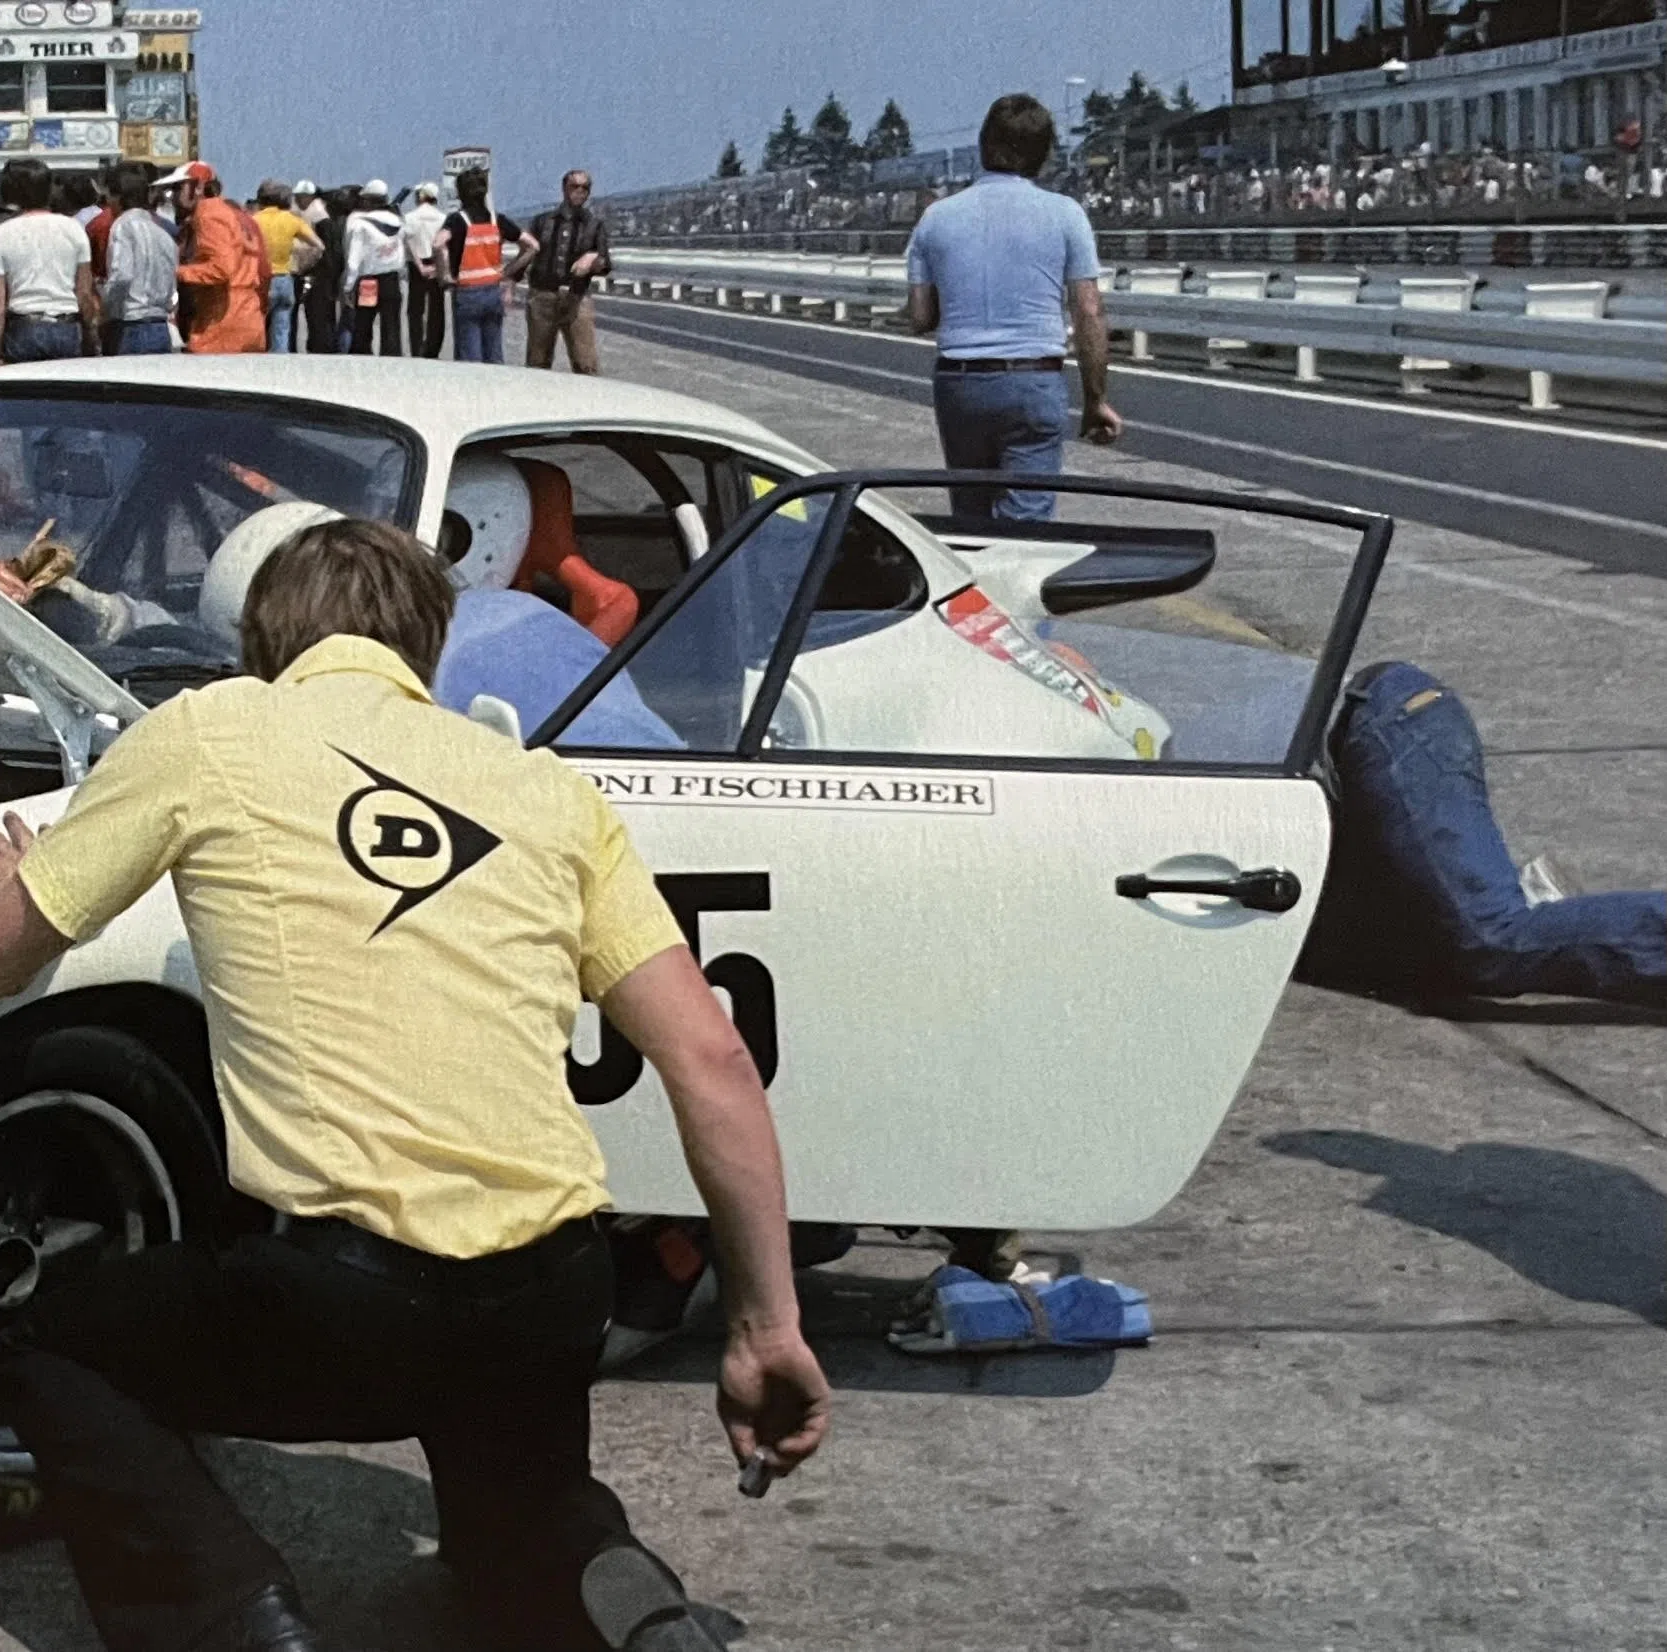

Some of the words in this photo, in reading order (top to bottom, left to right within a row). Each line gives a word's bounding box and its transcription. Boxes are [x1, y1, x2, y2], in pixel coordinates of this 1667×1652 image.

[30, 42, 95, 57] THIER
[671, 774, 985, 806] FISCHHABER
[370, 814, 441, 859] D
